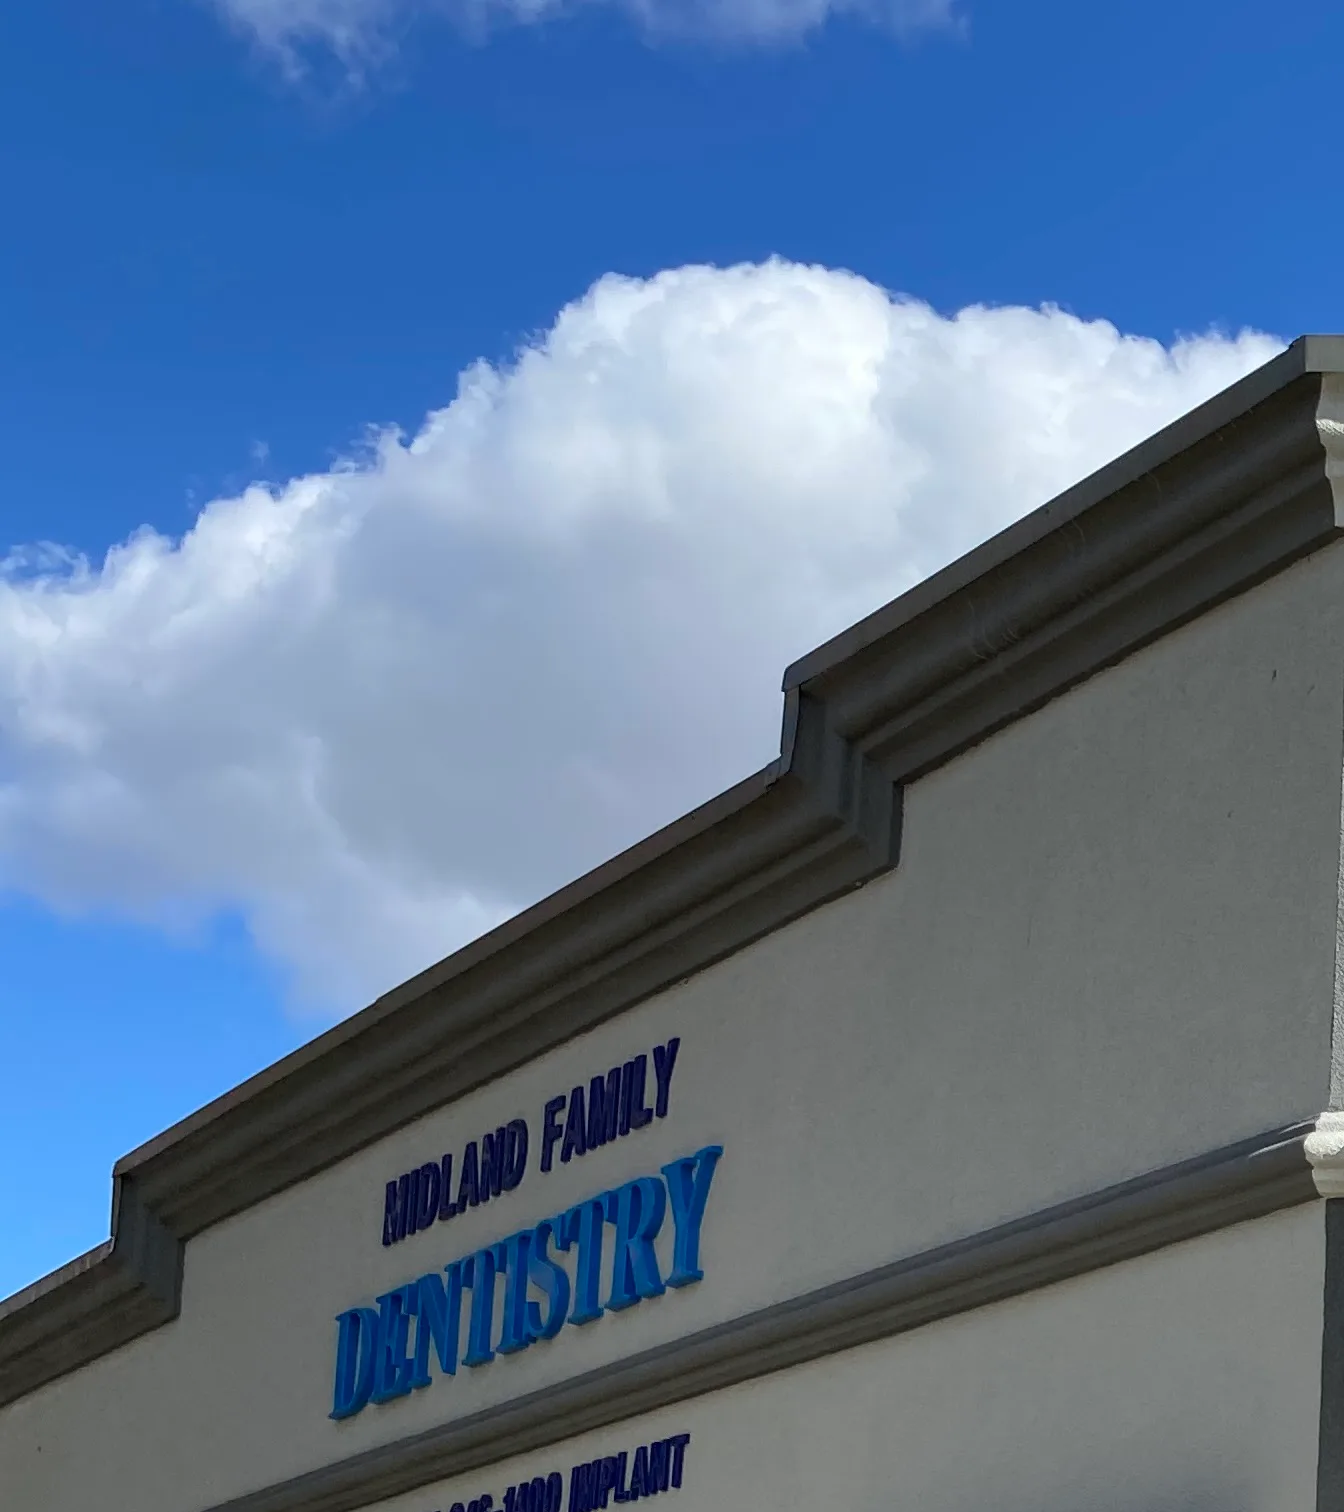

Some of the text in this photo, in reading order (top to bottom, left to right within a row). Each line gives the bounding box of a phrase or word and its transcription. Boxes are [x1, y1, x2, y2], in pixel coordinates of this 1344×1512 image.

[382, 1037, 680, 1246] MIDLAND FAMILY
[328, 1145, 724, 1420] DENTISTRY
